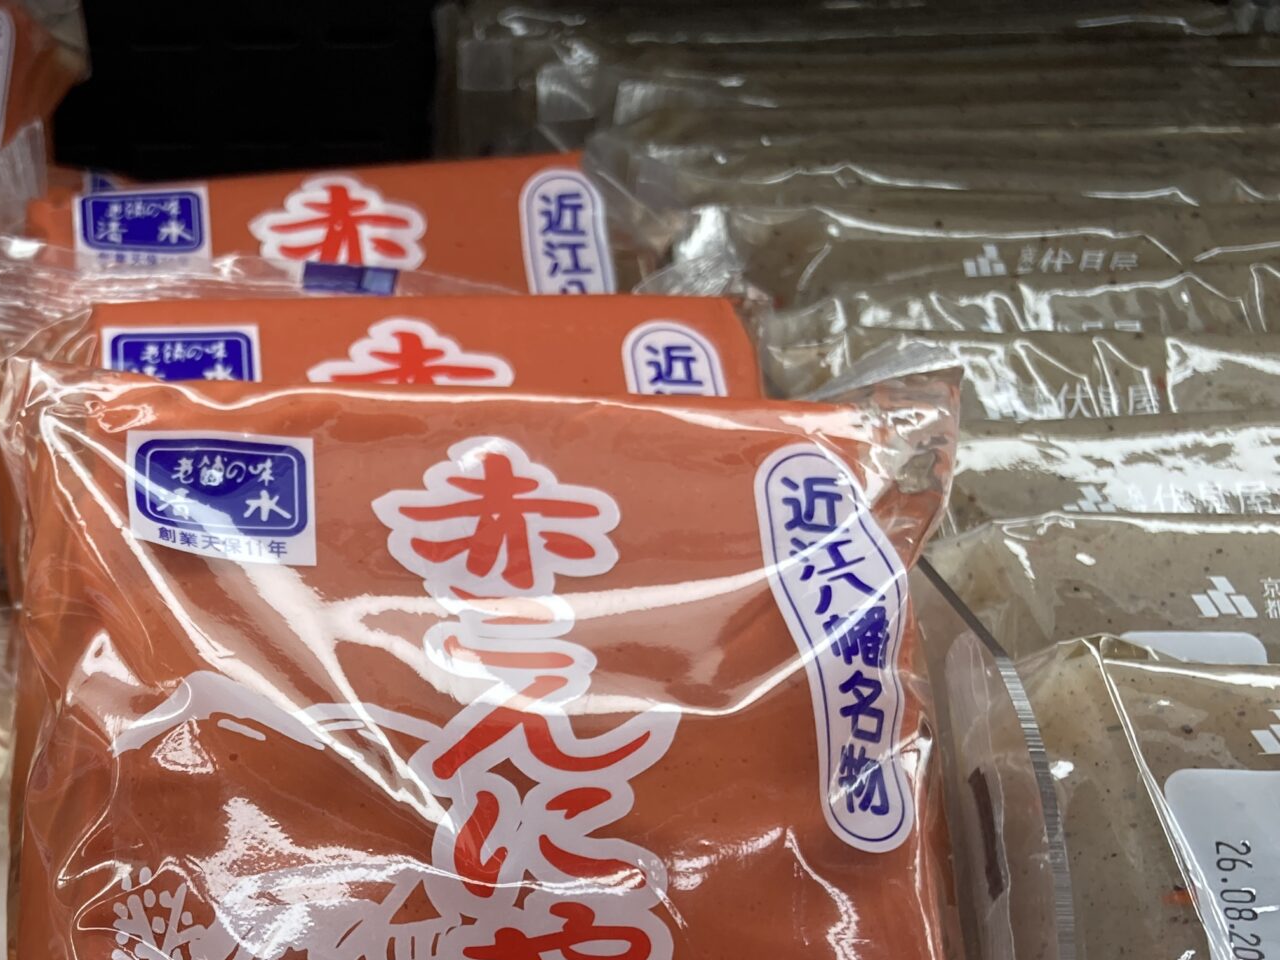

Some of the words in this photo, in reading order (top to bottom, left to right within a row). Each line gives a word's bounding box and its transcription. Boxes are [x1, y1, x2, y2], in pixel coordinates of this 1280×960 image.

[646, 345, 703, 394] 近
[782, 474, 892, 816] 近江八幡名物
